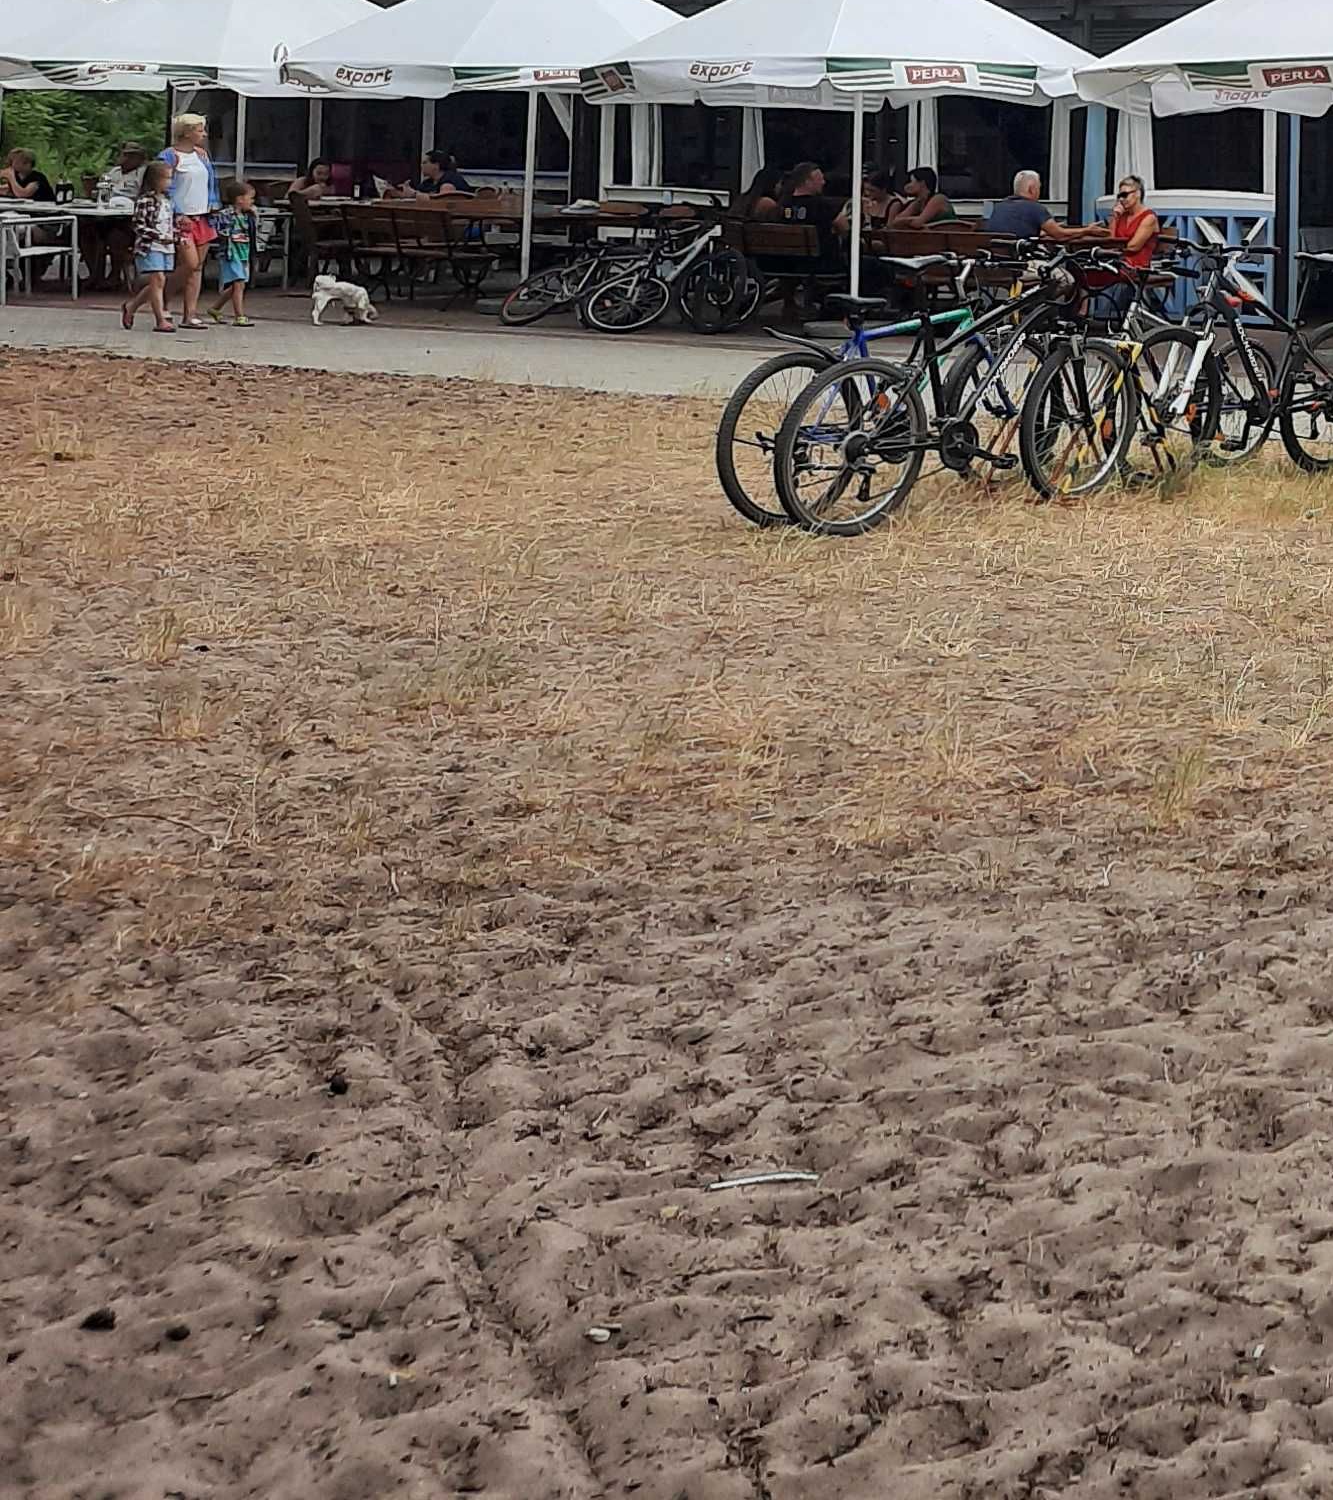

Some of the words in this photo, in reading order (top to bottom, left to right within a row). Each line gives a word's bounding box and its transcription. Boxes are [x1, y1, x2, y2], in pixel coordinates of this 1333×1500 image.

[335, 67, 393, 86] export
[689, 62, 754, 83] export
[1270, 68, 1325, 84] PERŁA
